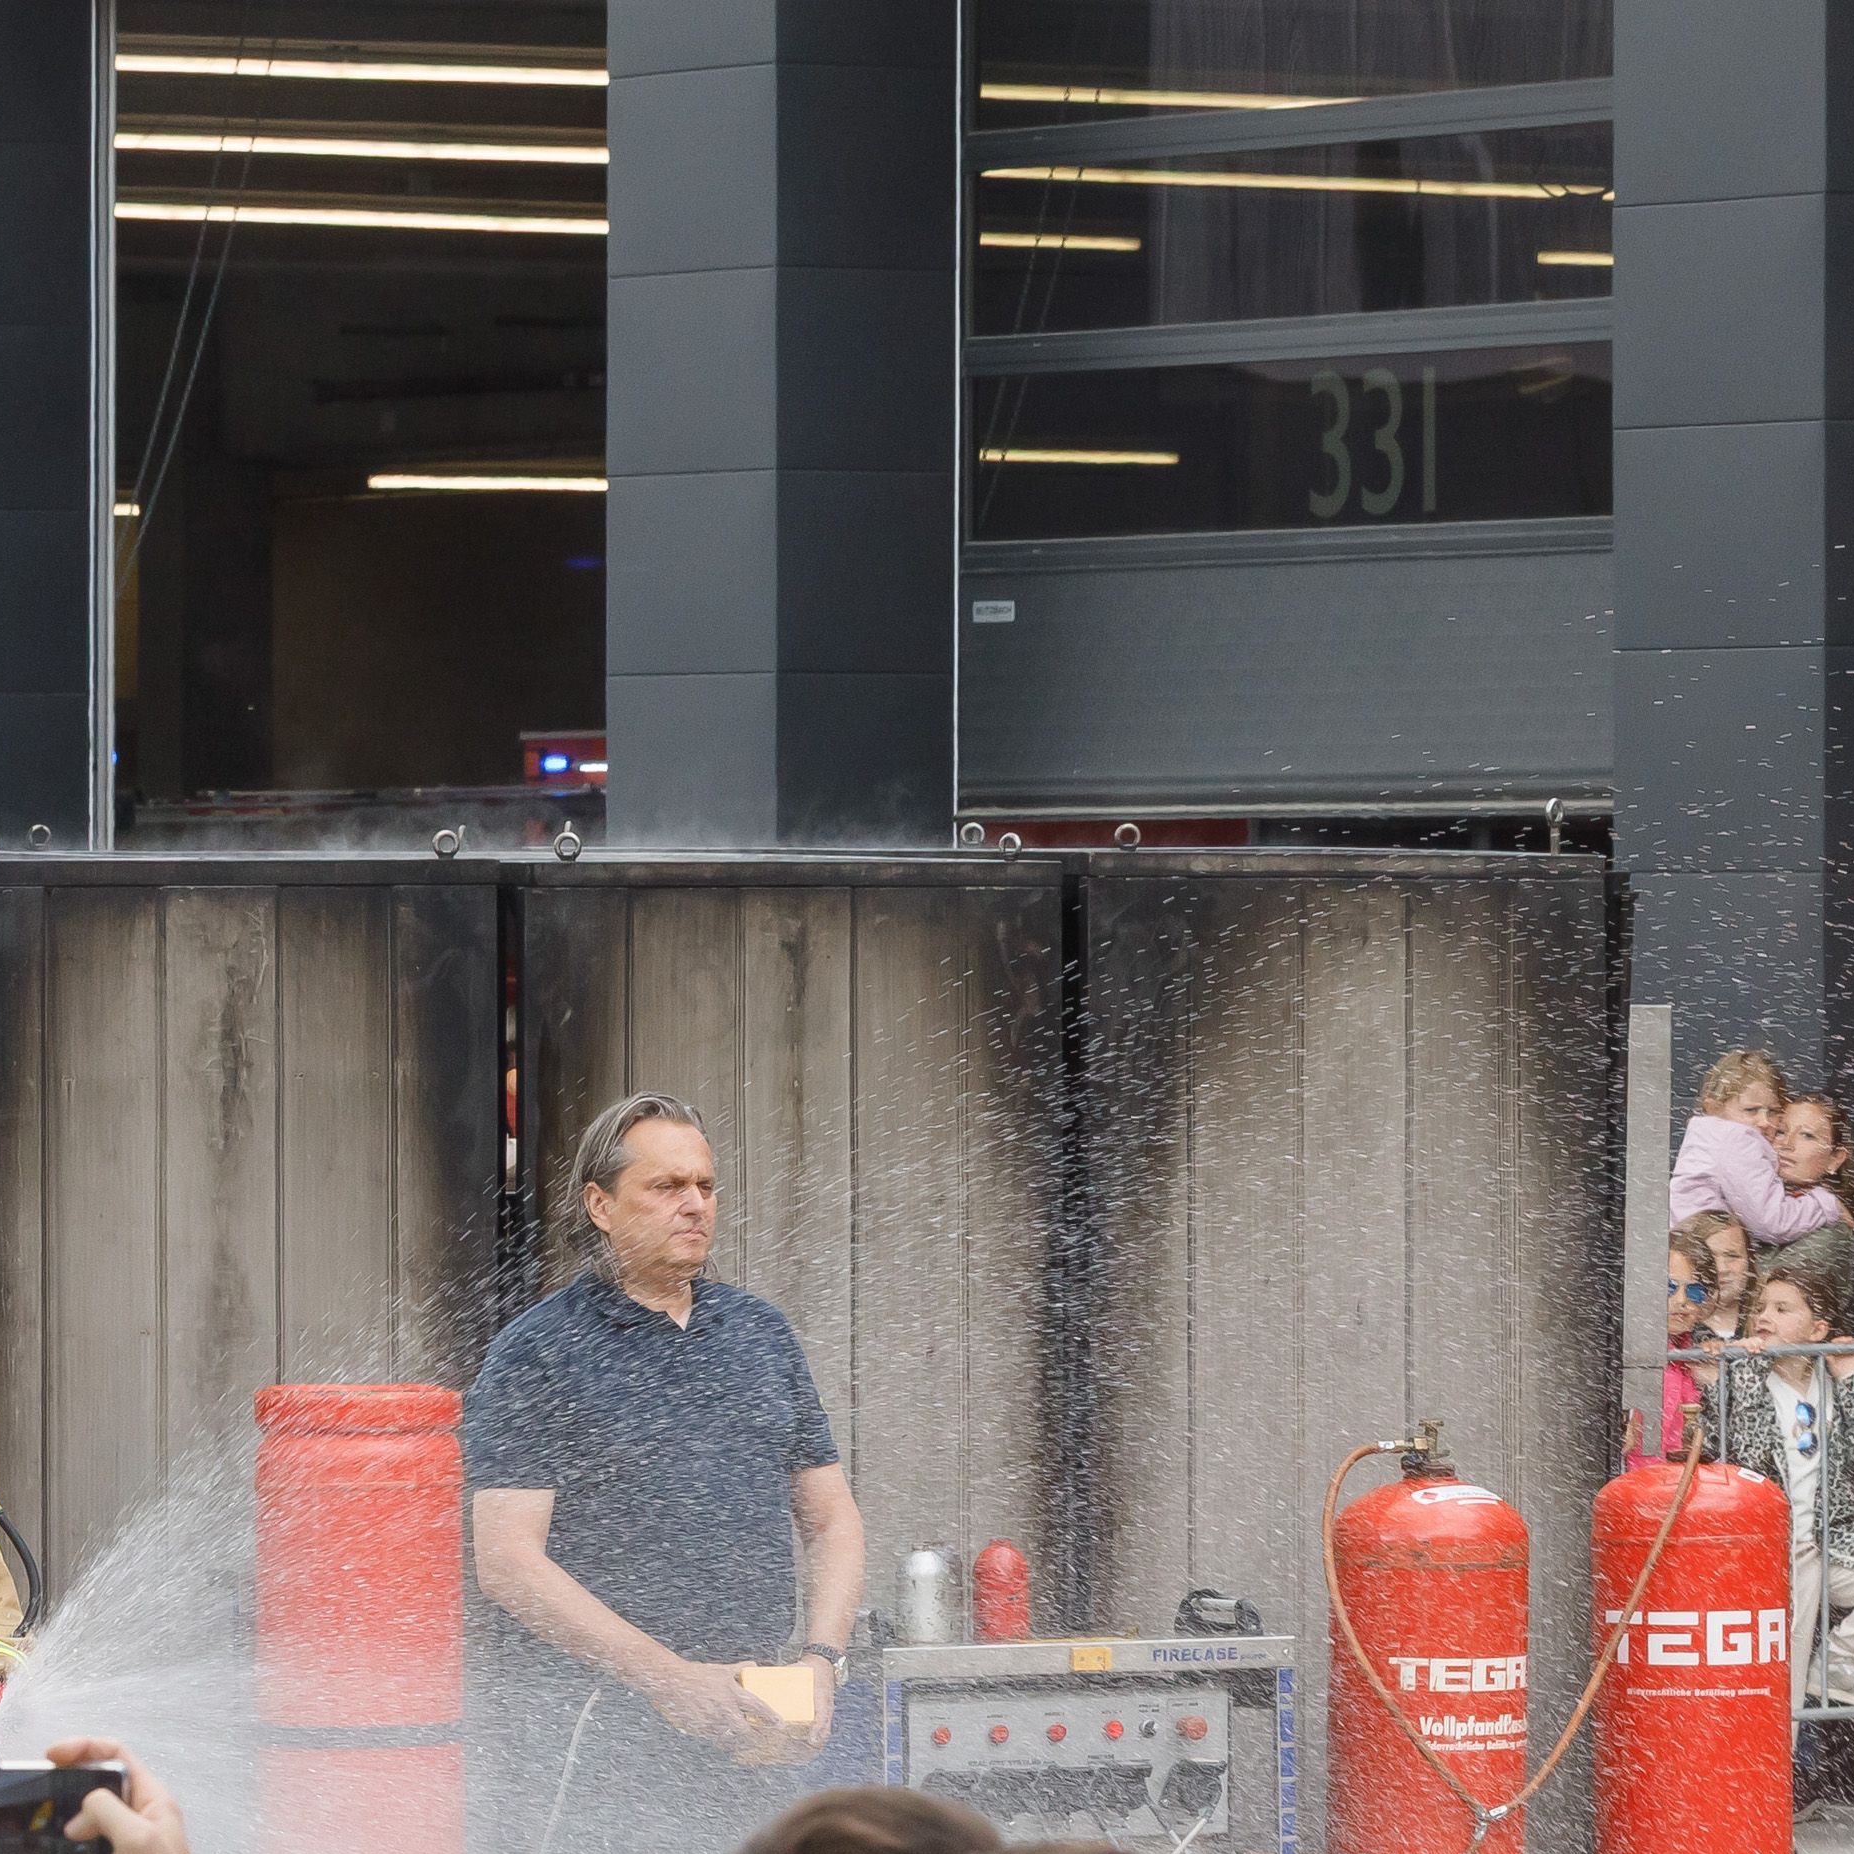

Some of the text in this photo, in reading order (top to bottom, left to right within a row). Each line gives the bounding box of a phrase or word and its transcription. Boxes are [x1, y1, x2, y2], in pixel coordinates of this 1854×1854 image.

[1152, 1647, 1238, 1662] FIRECASE
[1604, 1608, 1787, 1667] TEGA
[1388, 1655, 1528, 1692] TEGA
